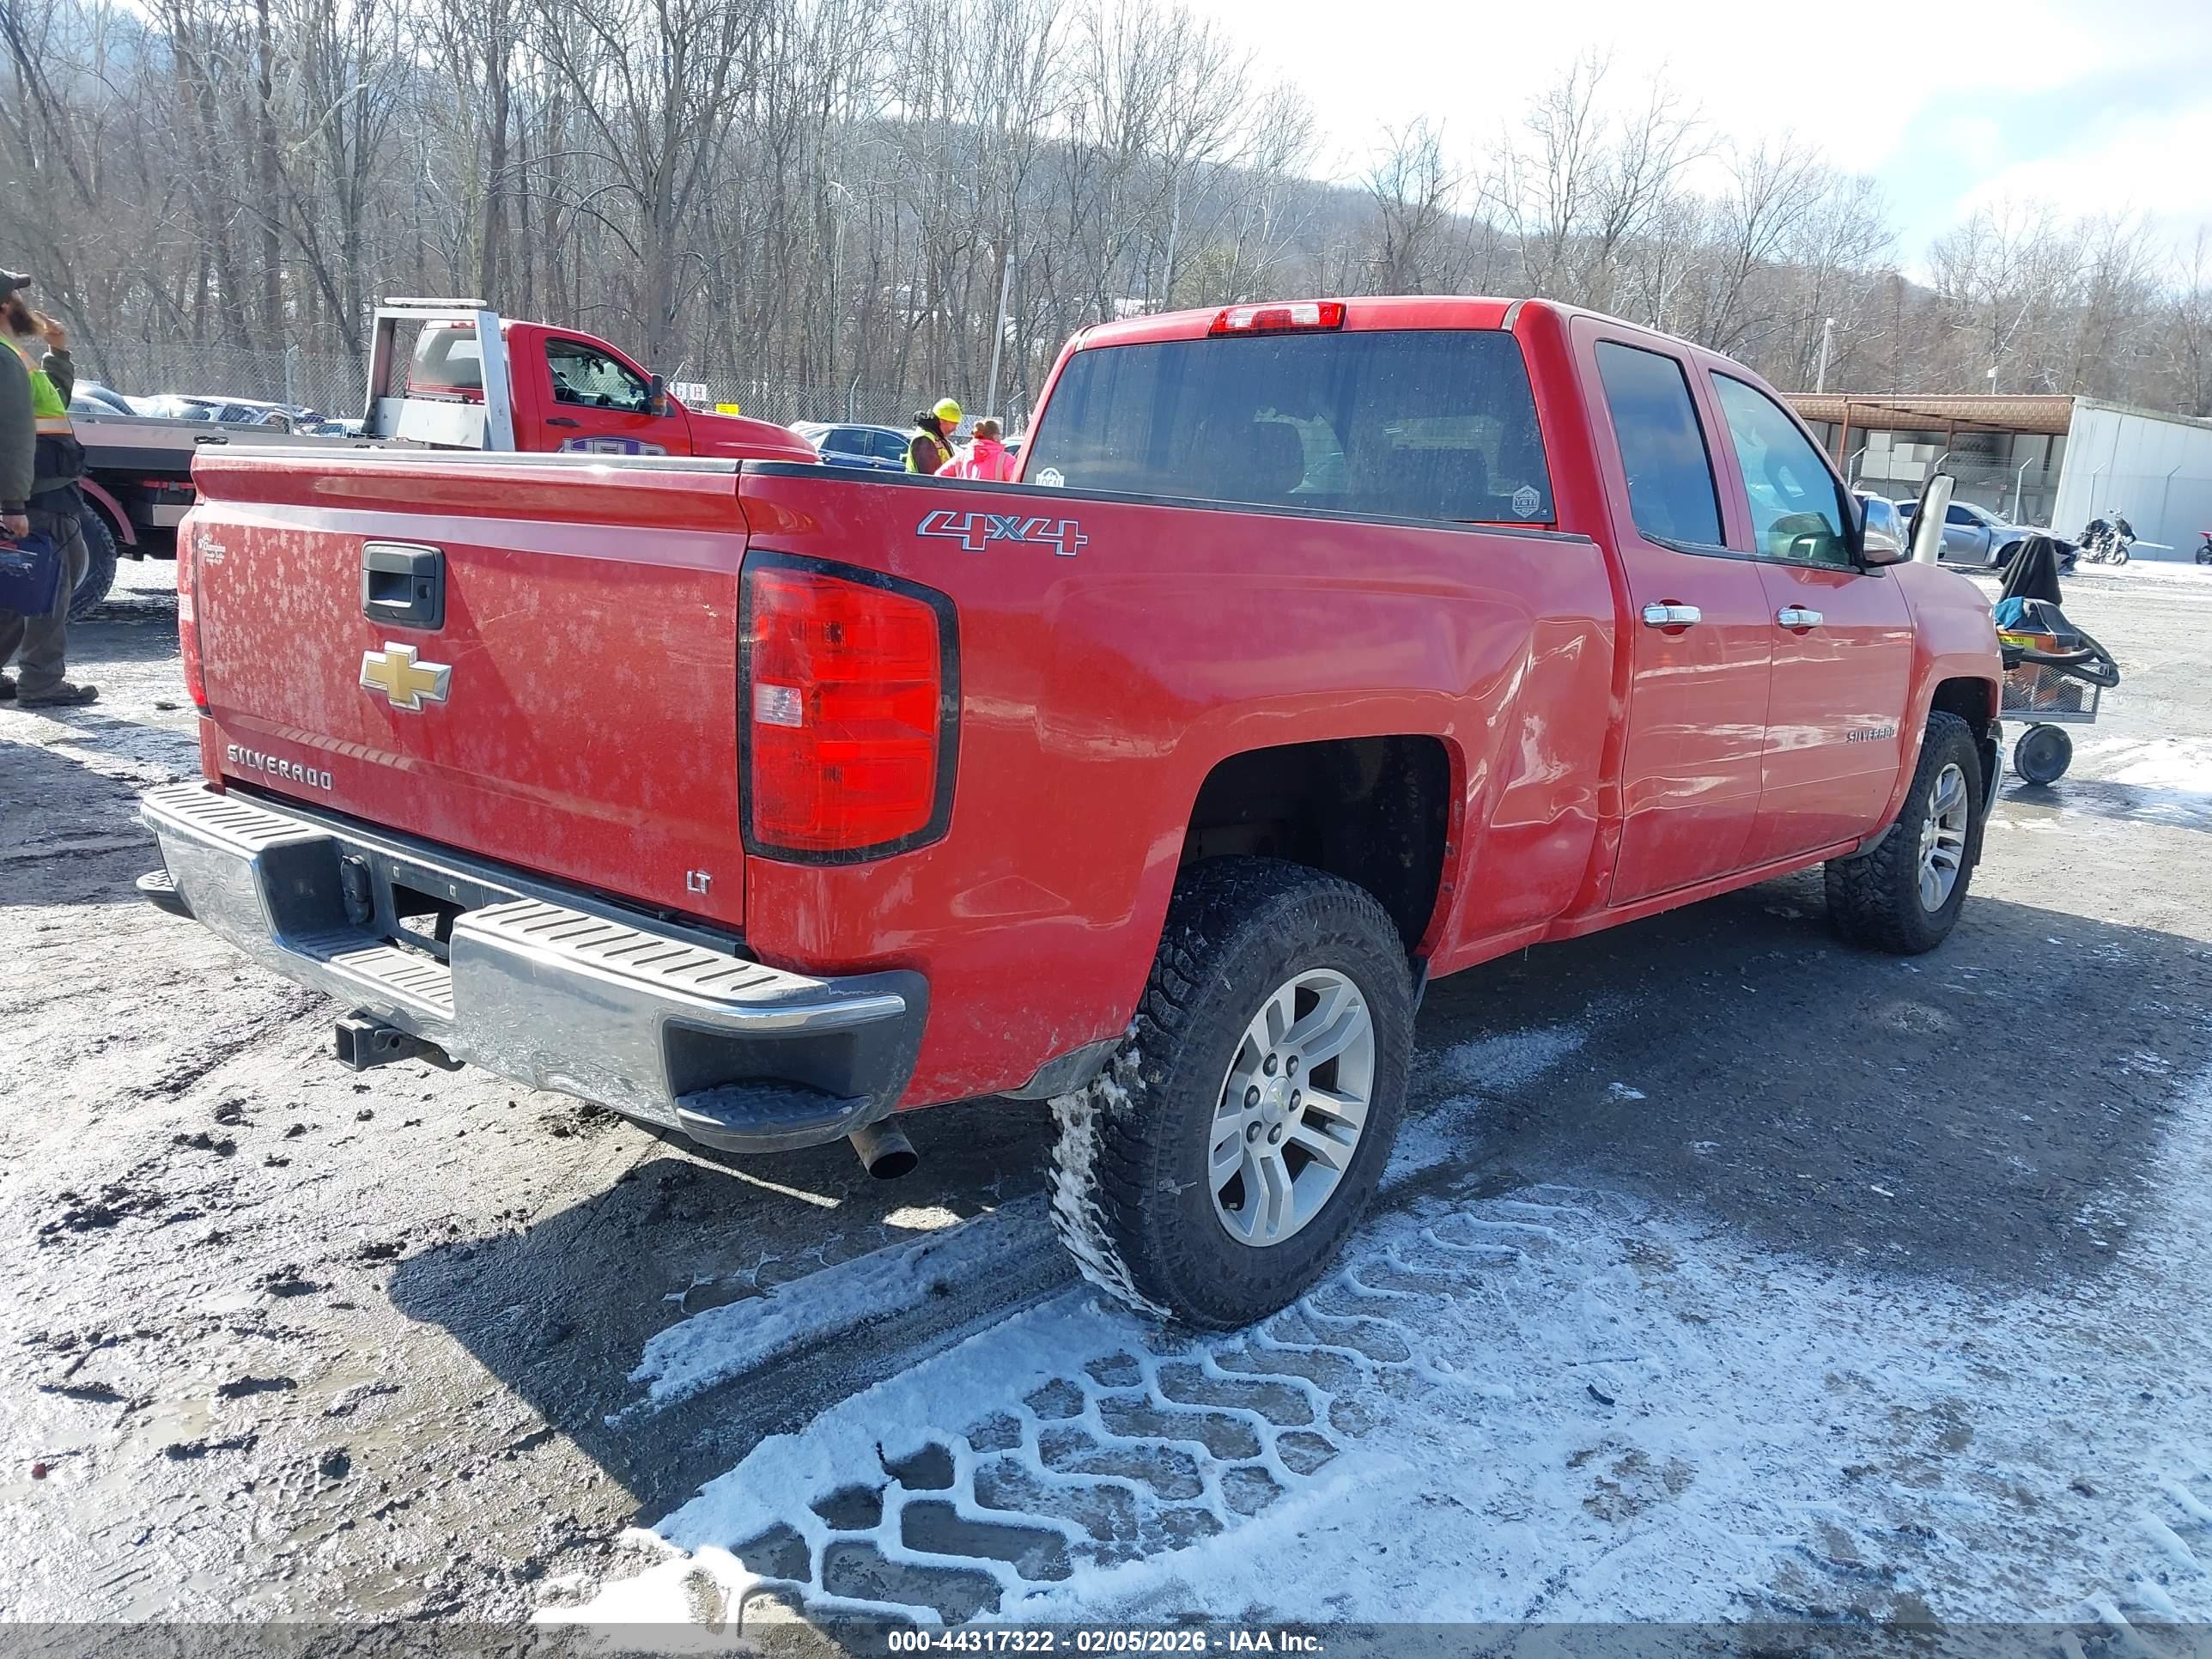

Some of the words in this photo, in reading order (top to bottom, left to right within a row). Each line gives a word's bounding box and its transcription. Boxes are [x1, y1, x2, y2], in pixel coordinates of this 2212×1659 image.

[694, 386, 702, 398] H
[1847, 727, 1896, 742] SILVERADO
[227, 744, 332, 790] SILVERADO
[687, 871, 711, 894] LT
